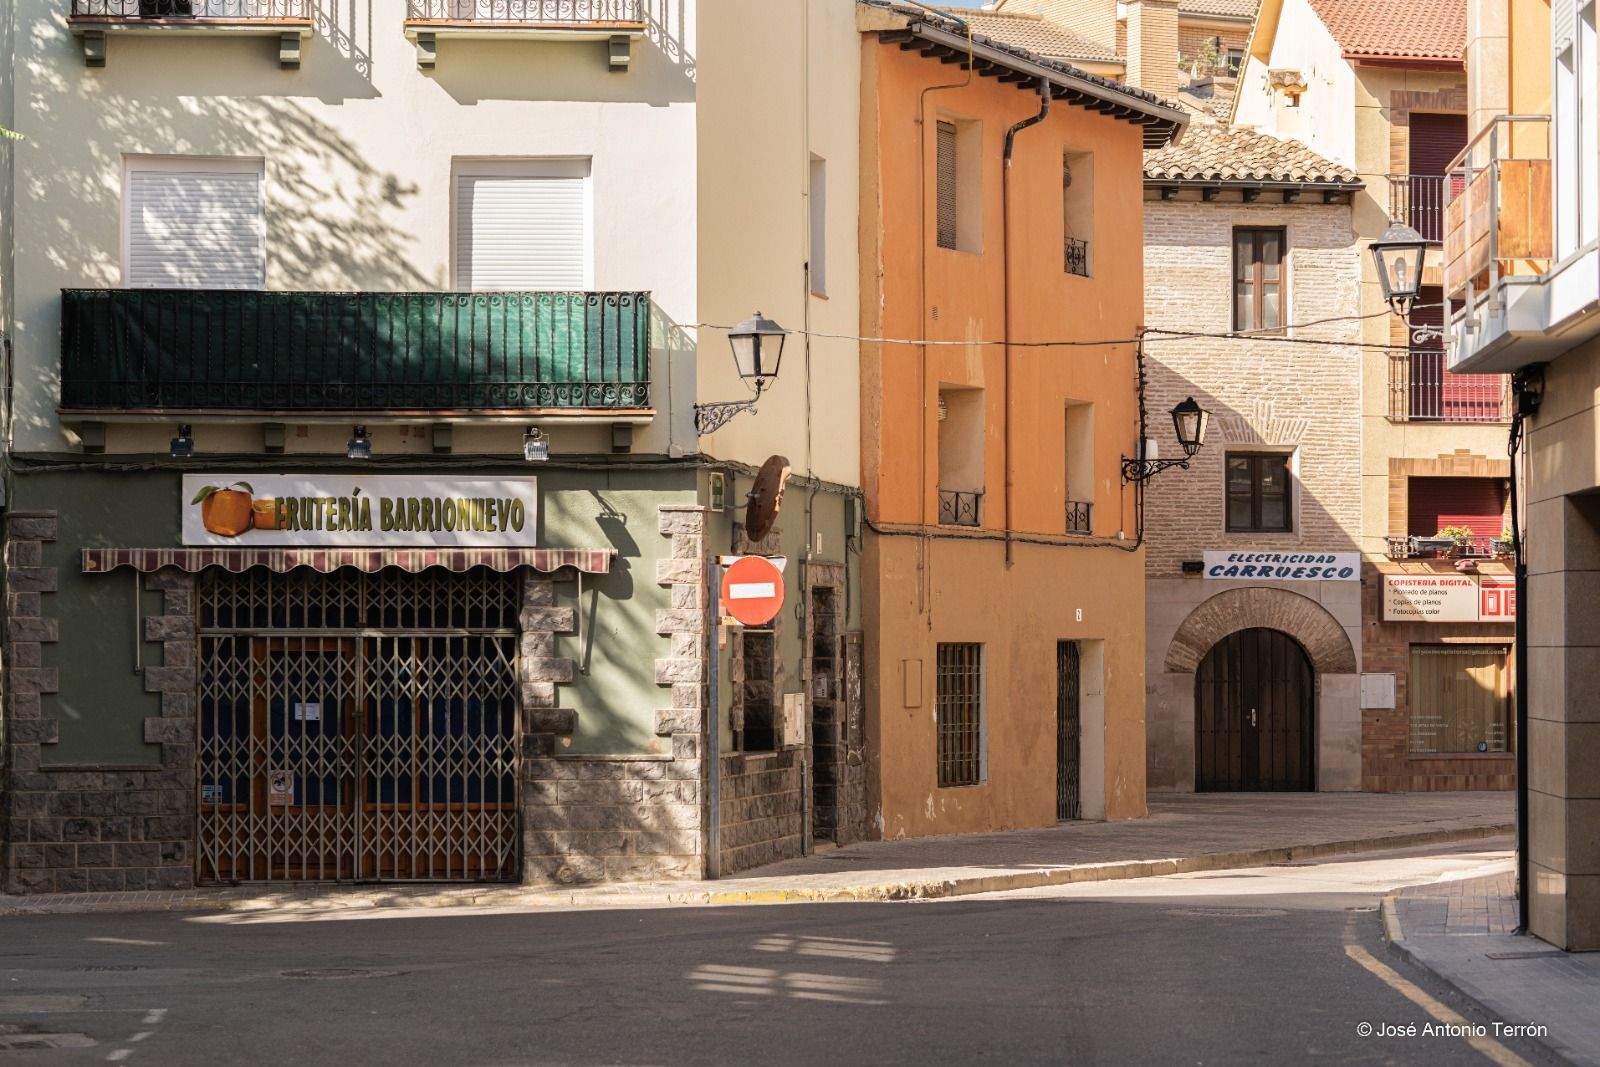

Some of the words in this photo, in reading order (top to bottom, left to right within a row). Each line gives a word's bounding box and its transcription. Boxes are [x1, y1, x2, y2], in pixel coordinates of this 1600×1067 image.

[274, 486, 373, 533] FRUTERÍA
[380, 496, 526, 533] BARRIONUEVO
[1227, 553, 1337, 564] ELECTRICIDAD
[1208, 564, 1354, 579] CARRUESCO
[1439, 579, 1473, 587] DIGITAL
[1428, 588, 1448, 597] planos
[1393, 599, 1412, 607] Copias
[1393, 608, 1424, 617] Fotocopias
[1425, 608, 1440, 616] color
